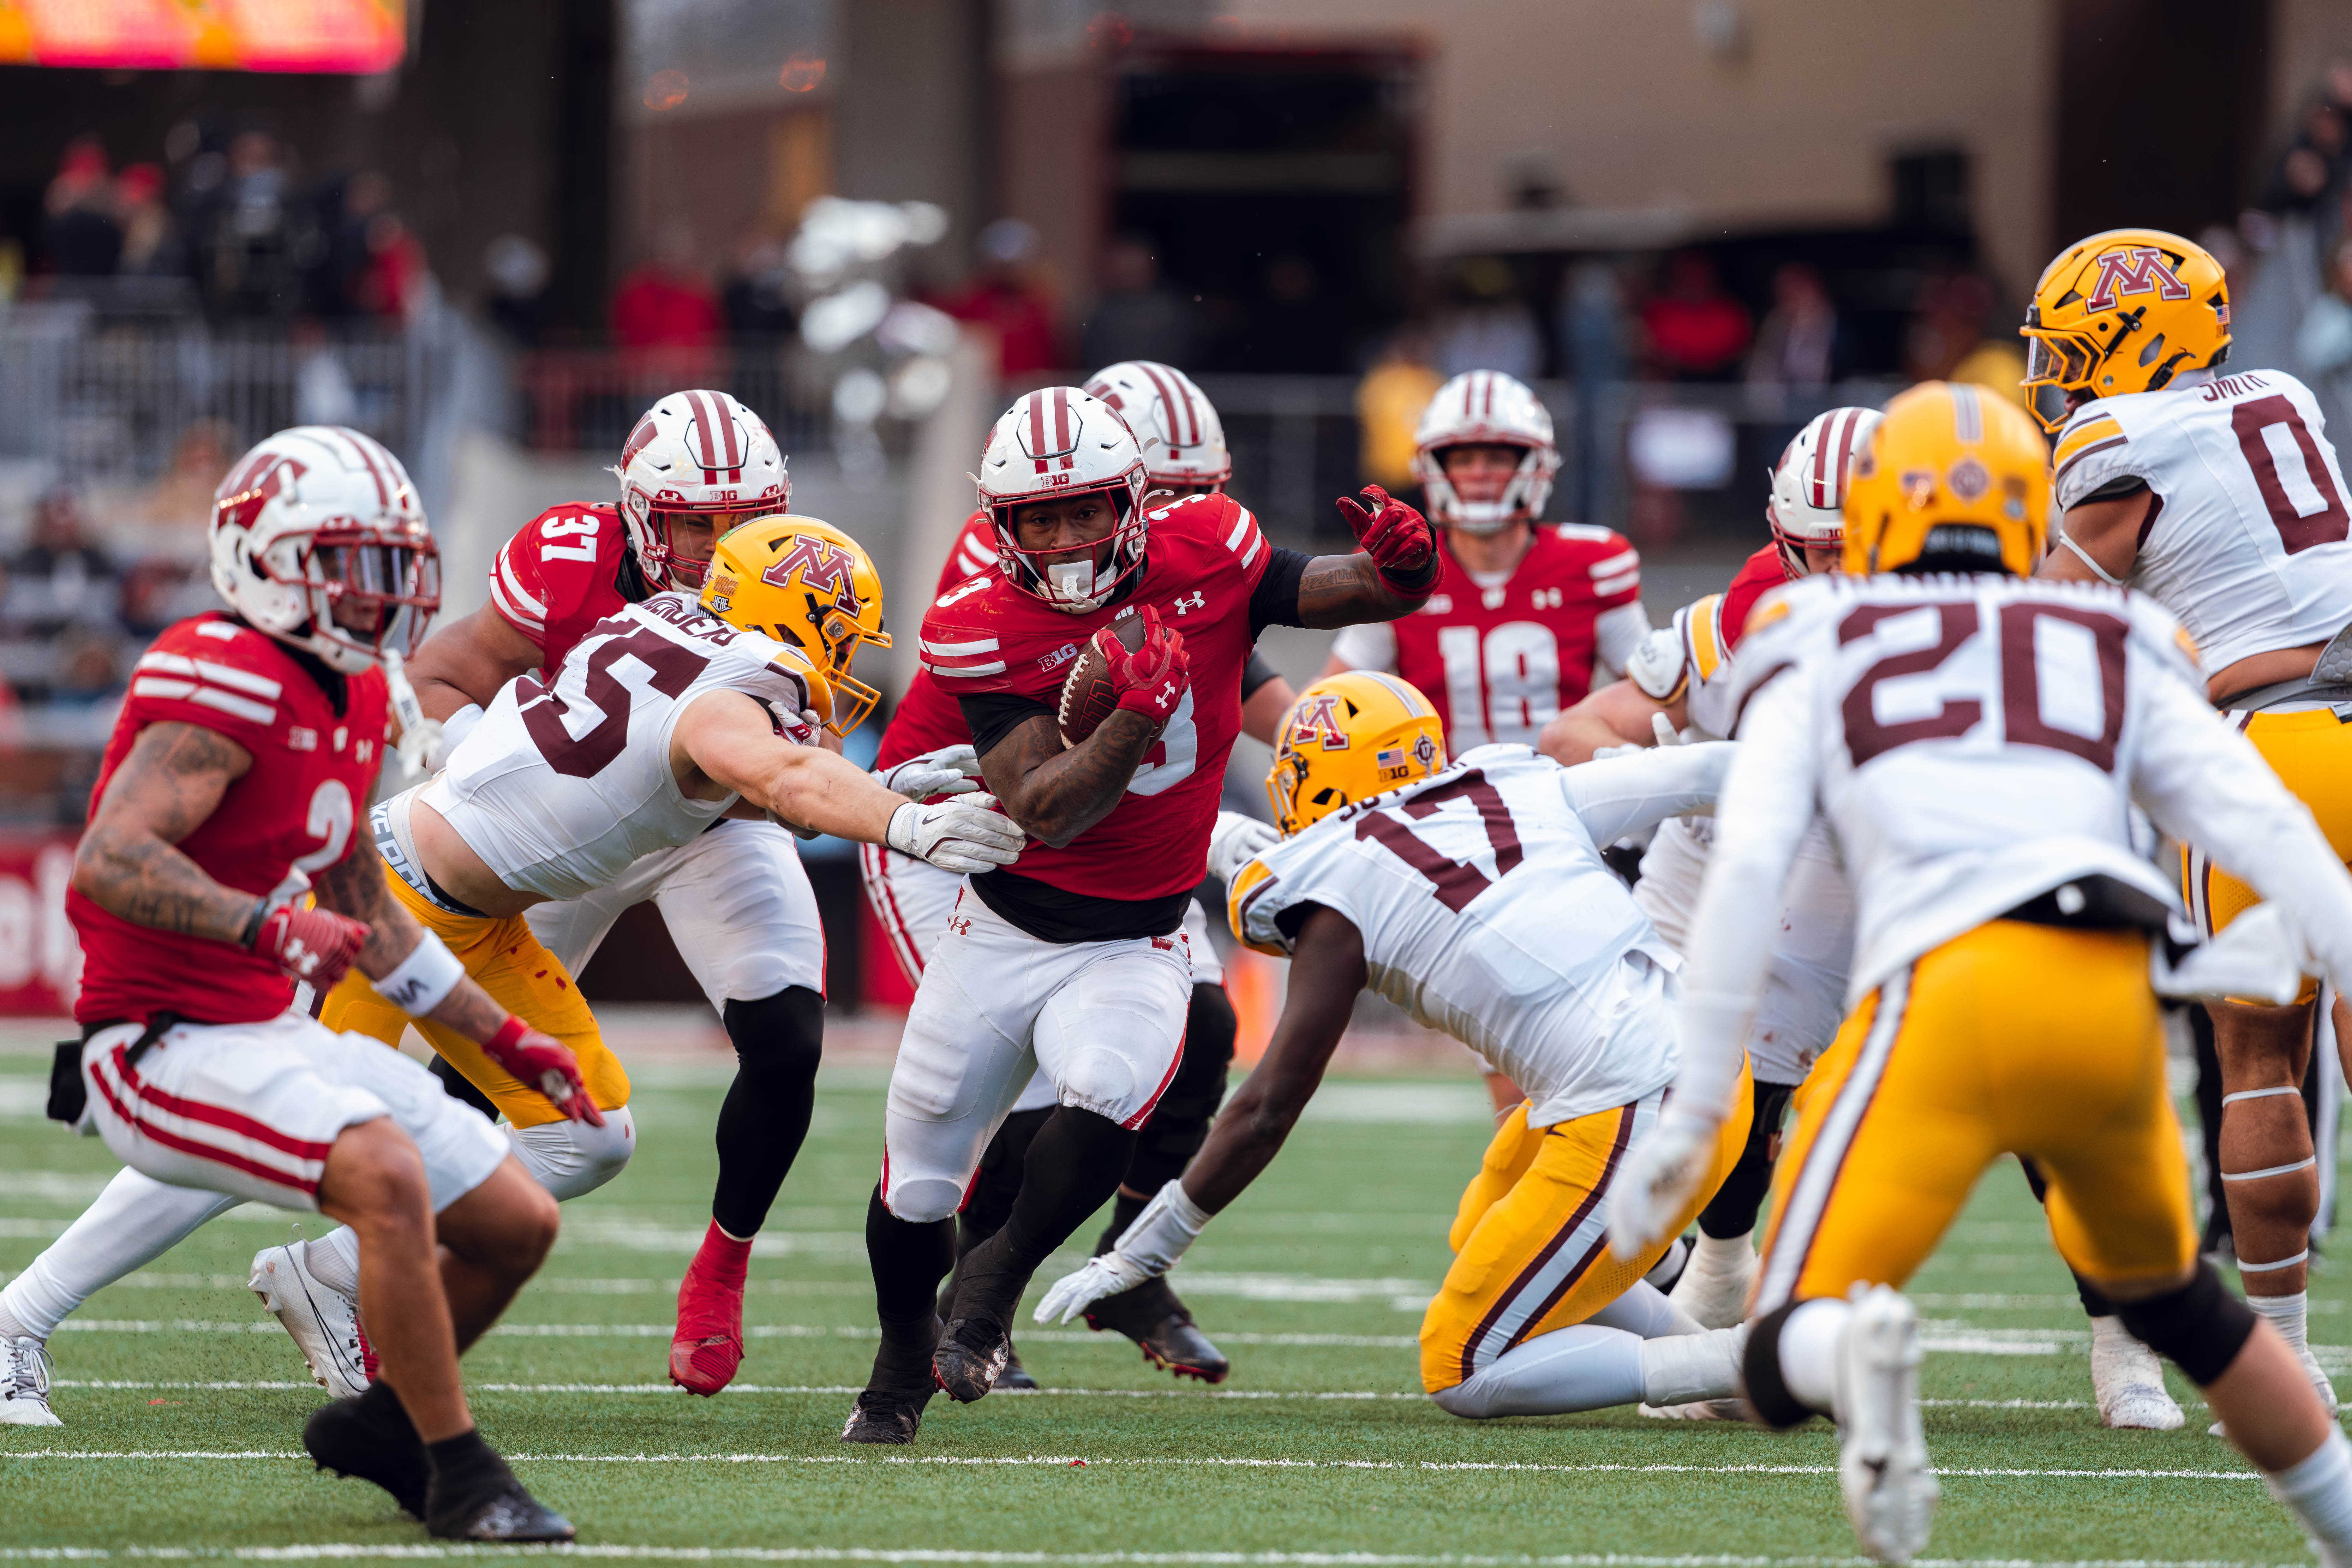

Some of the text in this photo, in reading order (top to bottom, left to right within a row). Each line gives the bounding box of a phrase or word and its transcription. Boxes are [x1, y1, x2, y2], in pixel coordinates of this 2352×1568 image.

[2086, 247, 2190, 314] M
[1149, 494, 1207, 521] 3
[2232, 393, 2351, 556] 0
[540, 514, 600, 563] 37
[760, 533, 861, 620] M
[714, 595, 729, 612] HERE
[936, 577, 992, 608] 3
[1437, 620, 1561, 762] 18
[1838, 601, 2130, 774] 20
[1280, 695, 1349, 761] M
[265, 778, 353, 909] 2
[1355, 768, 1524, 914] 17
